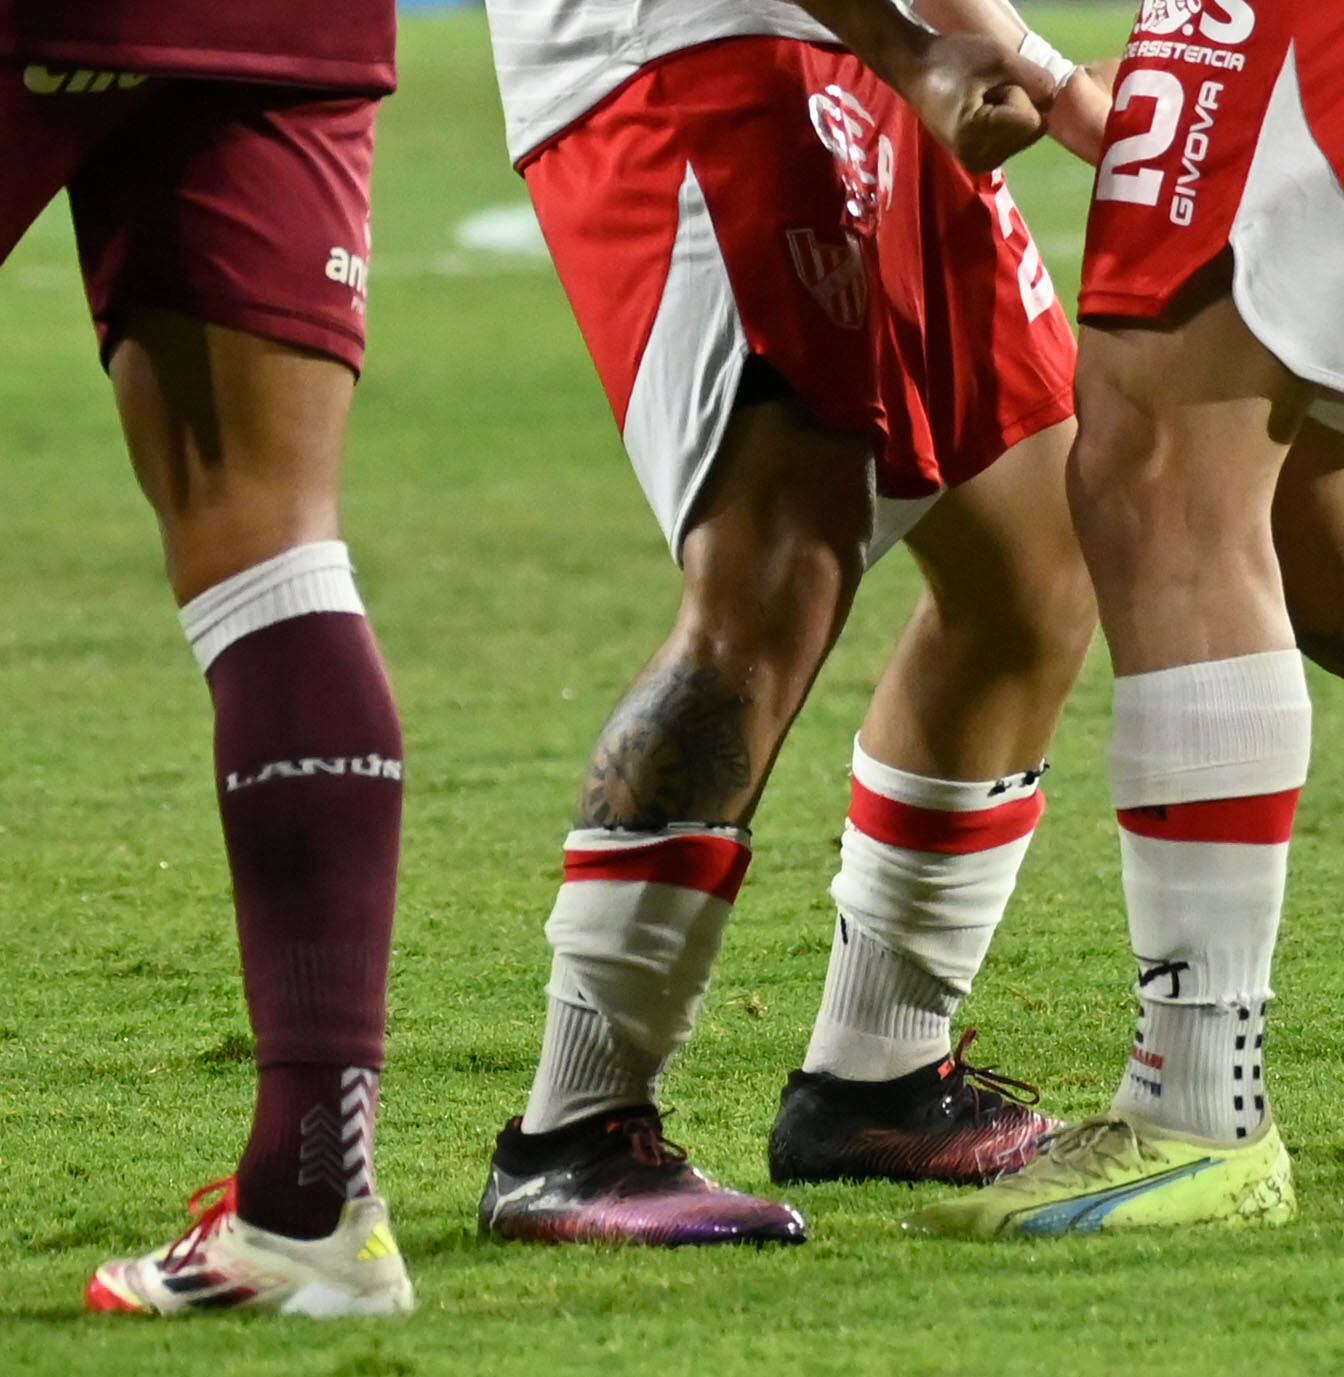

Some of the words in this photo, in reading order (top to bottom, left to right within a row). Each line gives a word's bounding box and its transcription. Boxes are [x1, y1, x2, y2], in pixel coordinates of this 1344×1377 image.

[1137, 40, 1246, 72] ASISTENCIA
[1095, 69, 1185, 207] 2
[1169, 80, 1224, 228] GIVOVA
